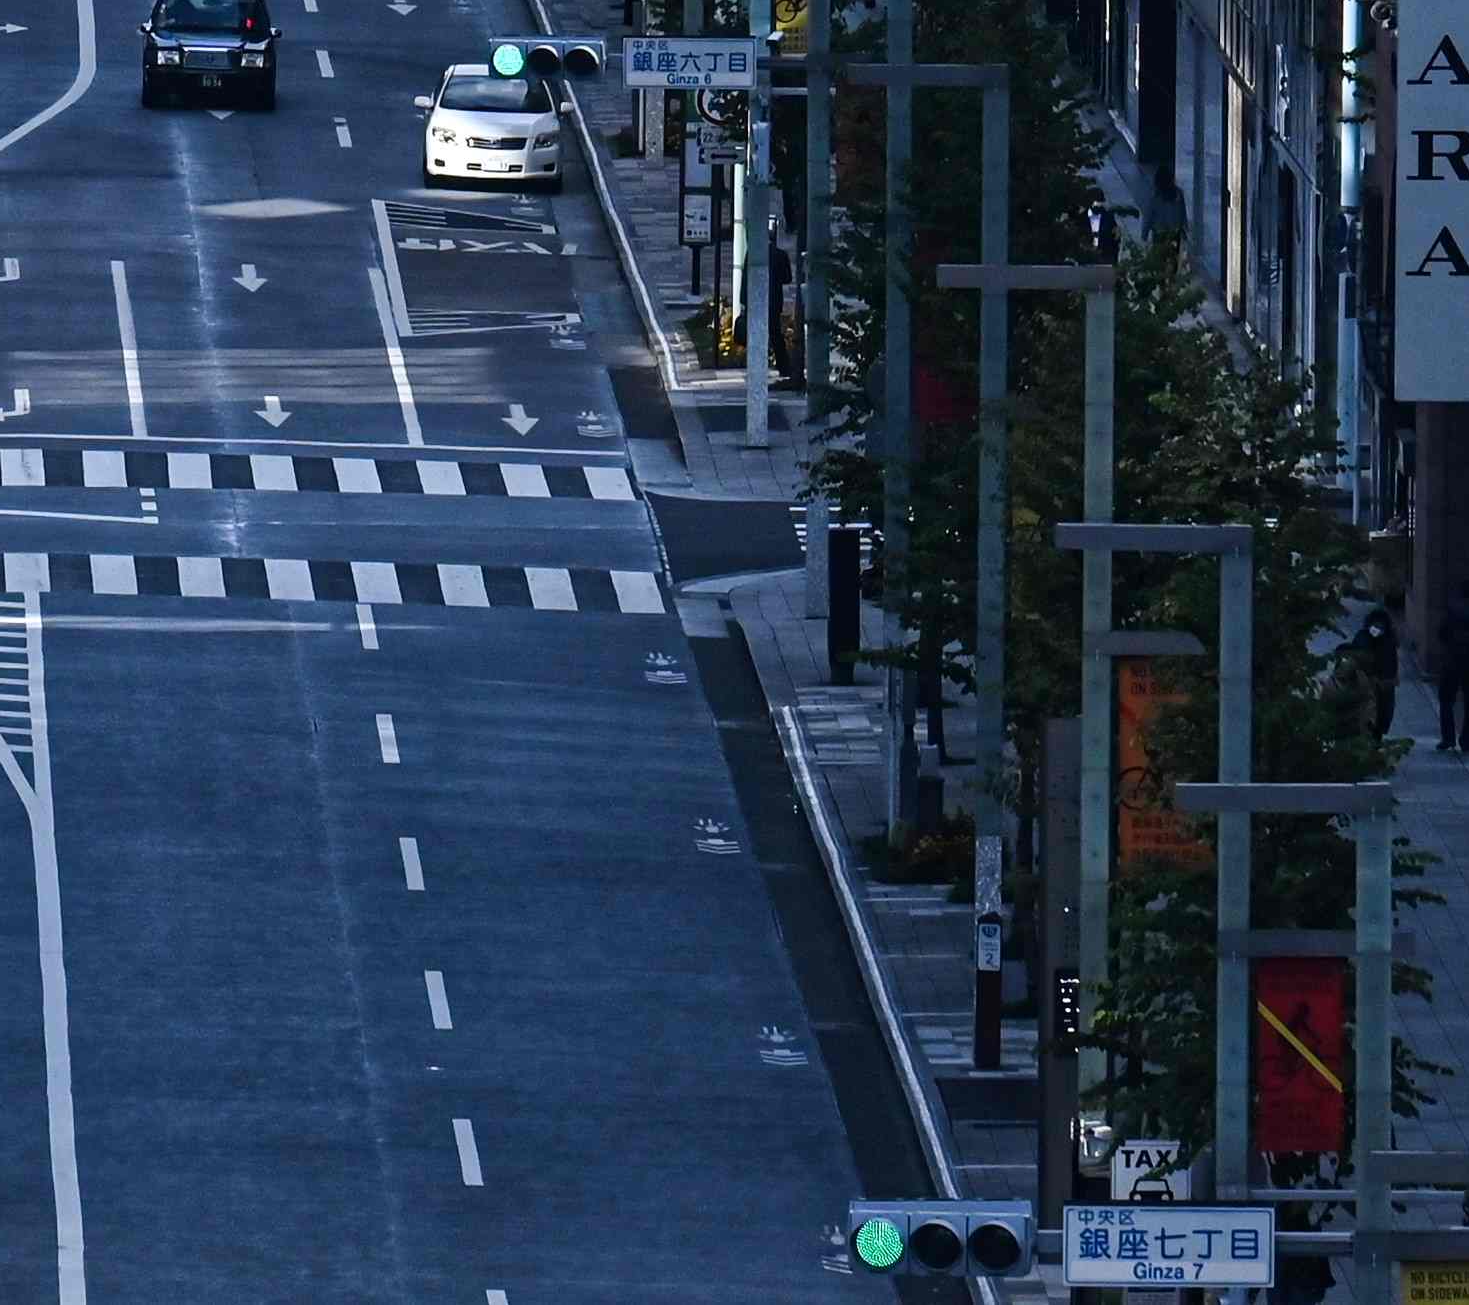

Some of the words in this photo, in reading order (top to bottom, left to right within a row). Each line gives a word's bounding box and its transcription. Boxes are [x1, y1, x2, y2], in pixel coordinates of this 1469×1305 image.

[631, 50, 748, 74] 銀座六丁目
[666, 72, 701, 88] Ginza
[1121, 1149, 1172, 1169] TAX
[1077, 1209, 1135, 1225] 中央区
[1078, 1229, 1262, 1260] 銀座七丁目
[1132, 1263, 1185, 1284] Ginza
[1192, 1263, 1204, 1282] 7
[1409, 1271, 1426, 1283] NO
[1410, 1287, 1426, 1301] ON
